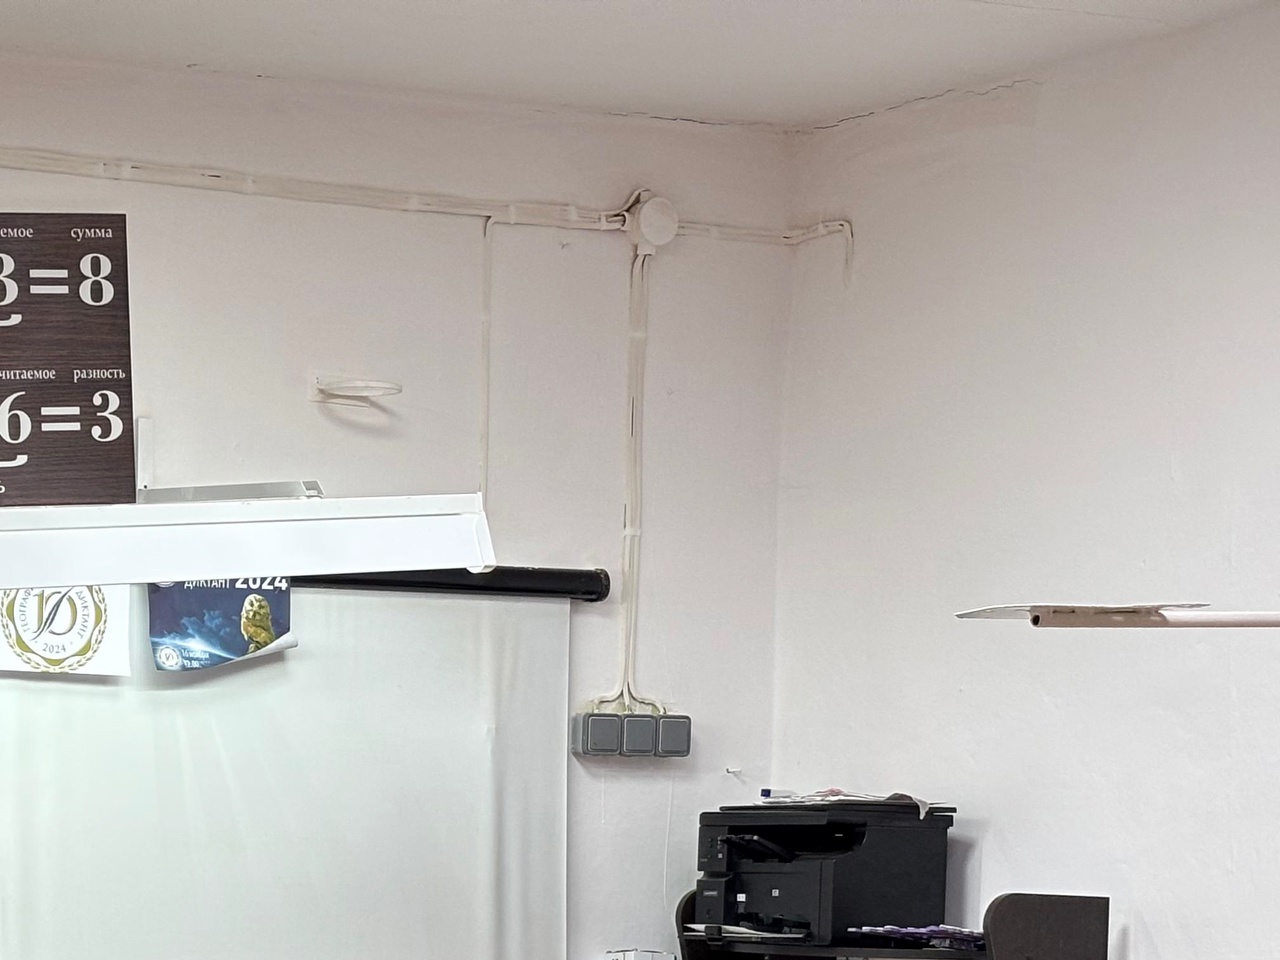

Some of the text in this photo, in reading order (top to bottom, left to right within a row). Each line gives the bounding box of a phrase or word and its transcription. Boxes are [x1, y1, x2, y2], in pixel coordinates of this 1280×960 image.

[70, 227, 113, 242] сумма
[73, 368, 126, 383] разность
[42, 643, 67, 654] 2024
